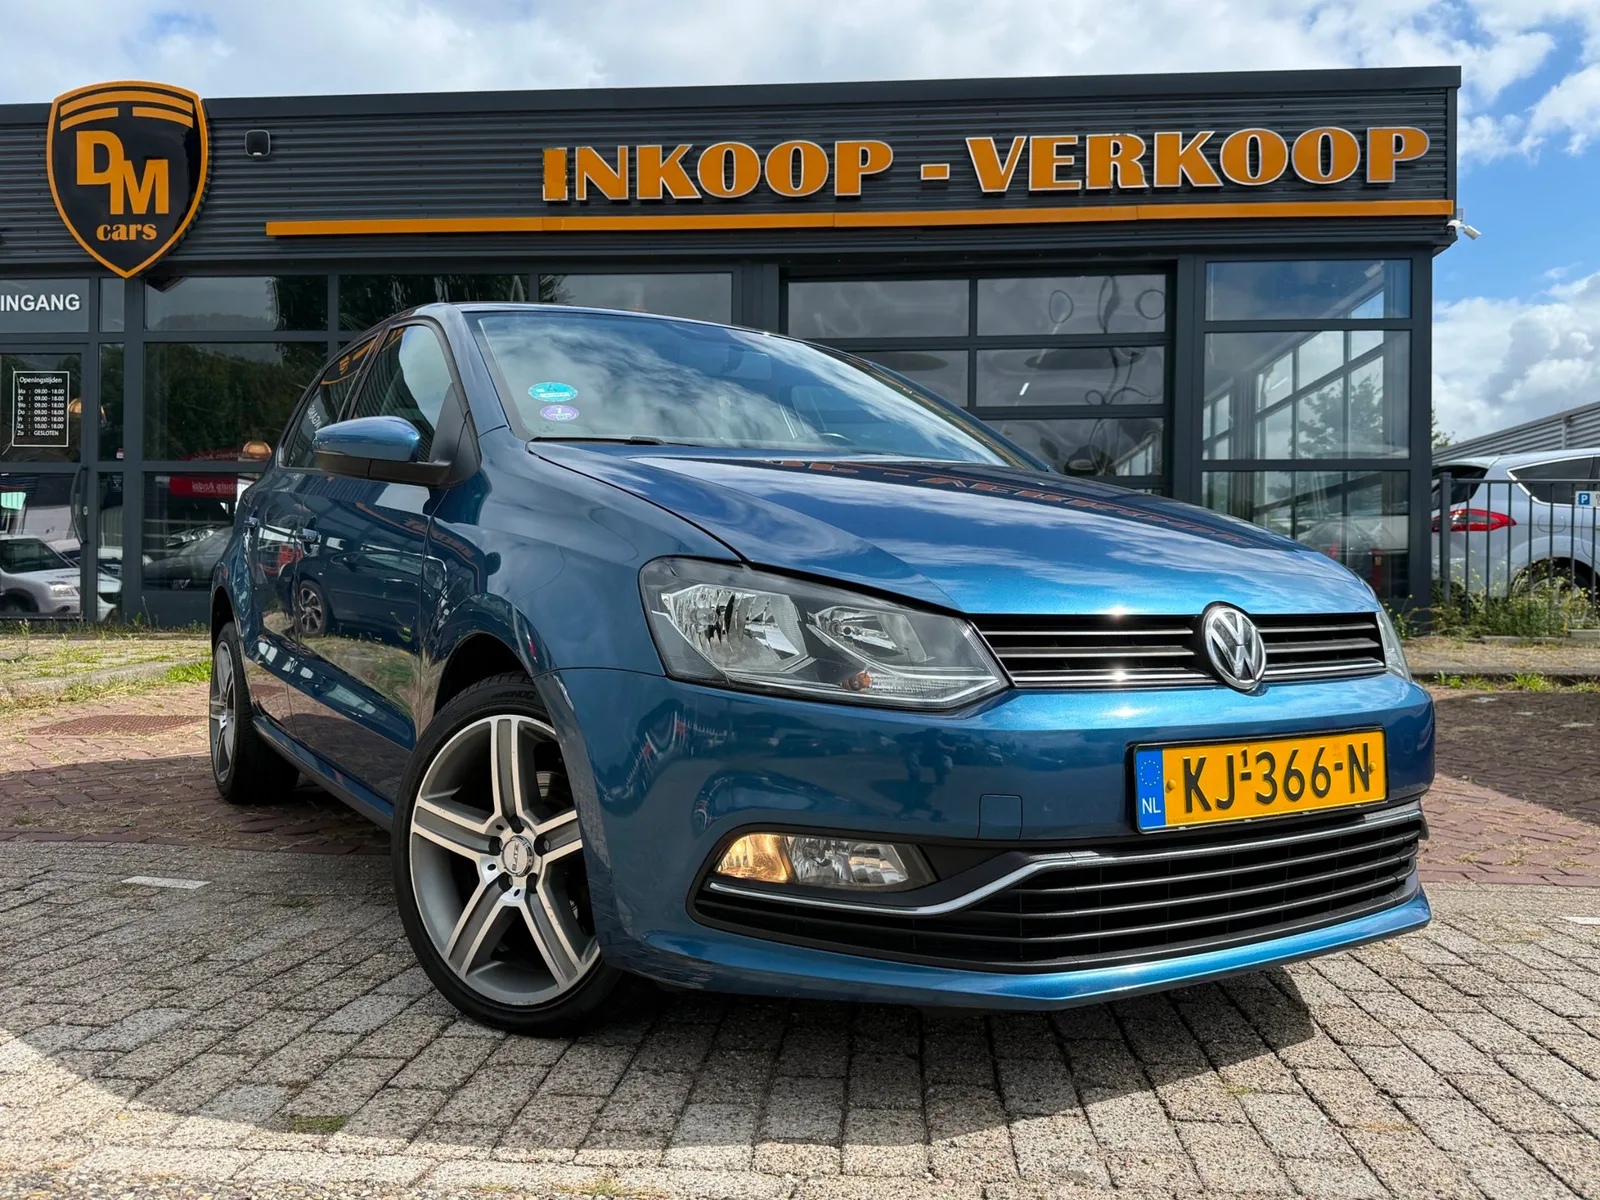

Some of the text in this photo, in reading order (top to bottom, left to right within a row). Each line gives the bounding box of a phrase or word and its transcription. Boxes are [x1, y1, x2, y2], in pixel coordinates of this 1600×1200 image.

[76, 130, 169, 215] DM
[542, 140, 893, 201] INKOOP
[965, 126, 1430, 193] VERKOOP
[96, 223, 157, 241] cars
[0, 293, 80, 312] INGANG
[19, 376, 63, 384] Openingstijden
[1183, 742, 1371, 814] KJ-366-N
[1142, 797, 1162, 815] NL
